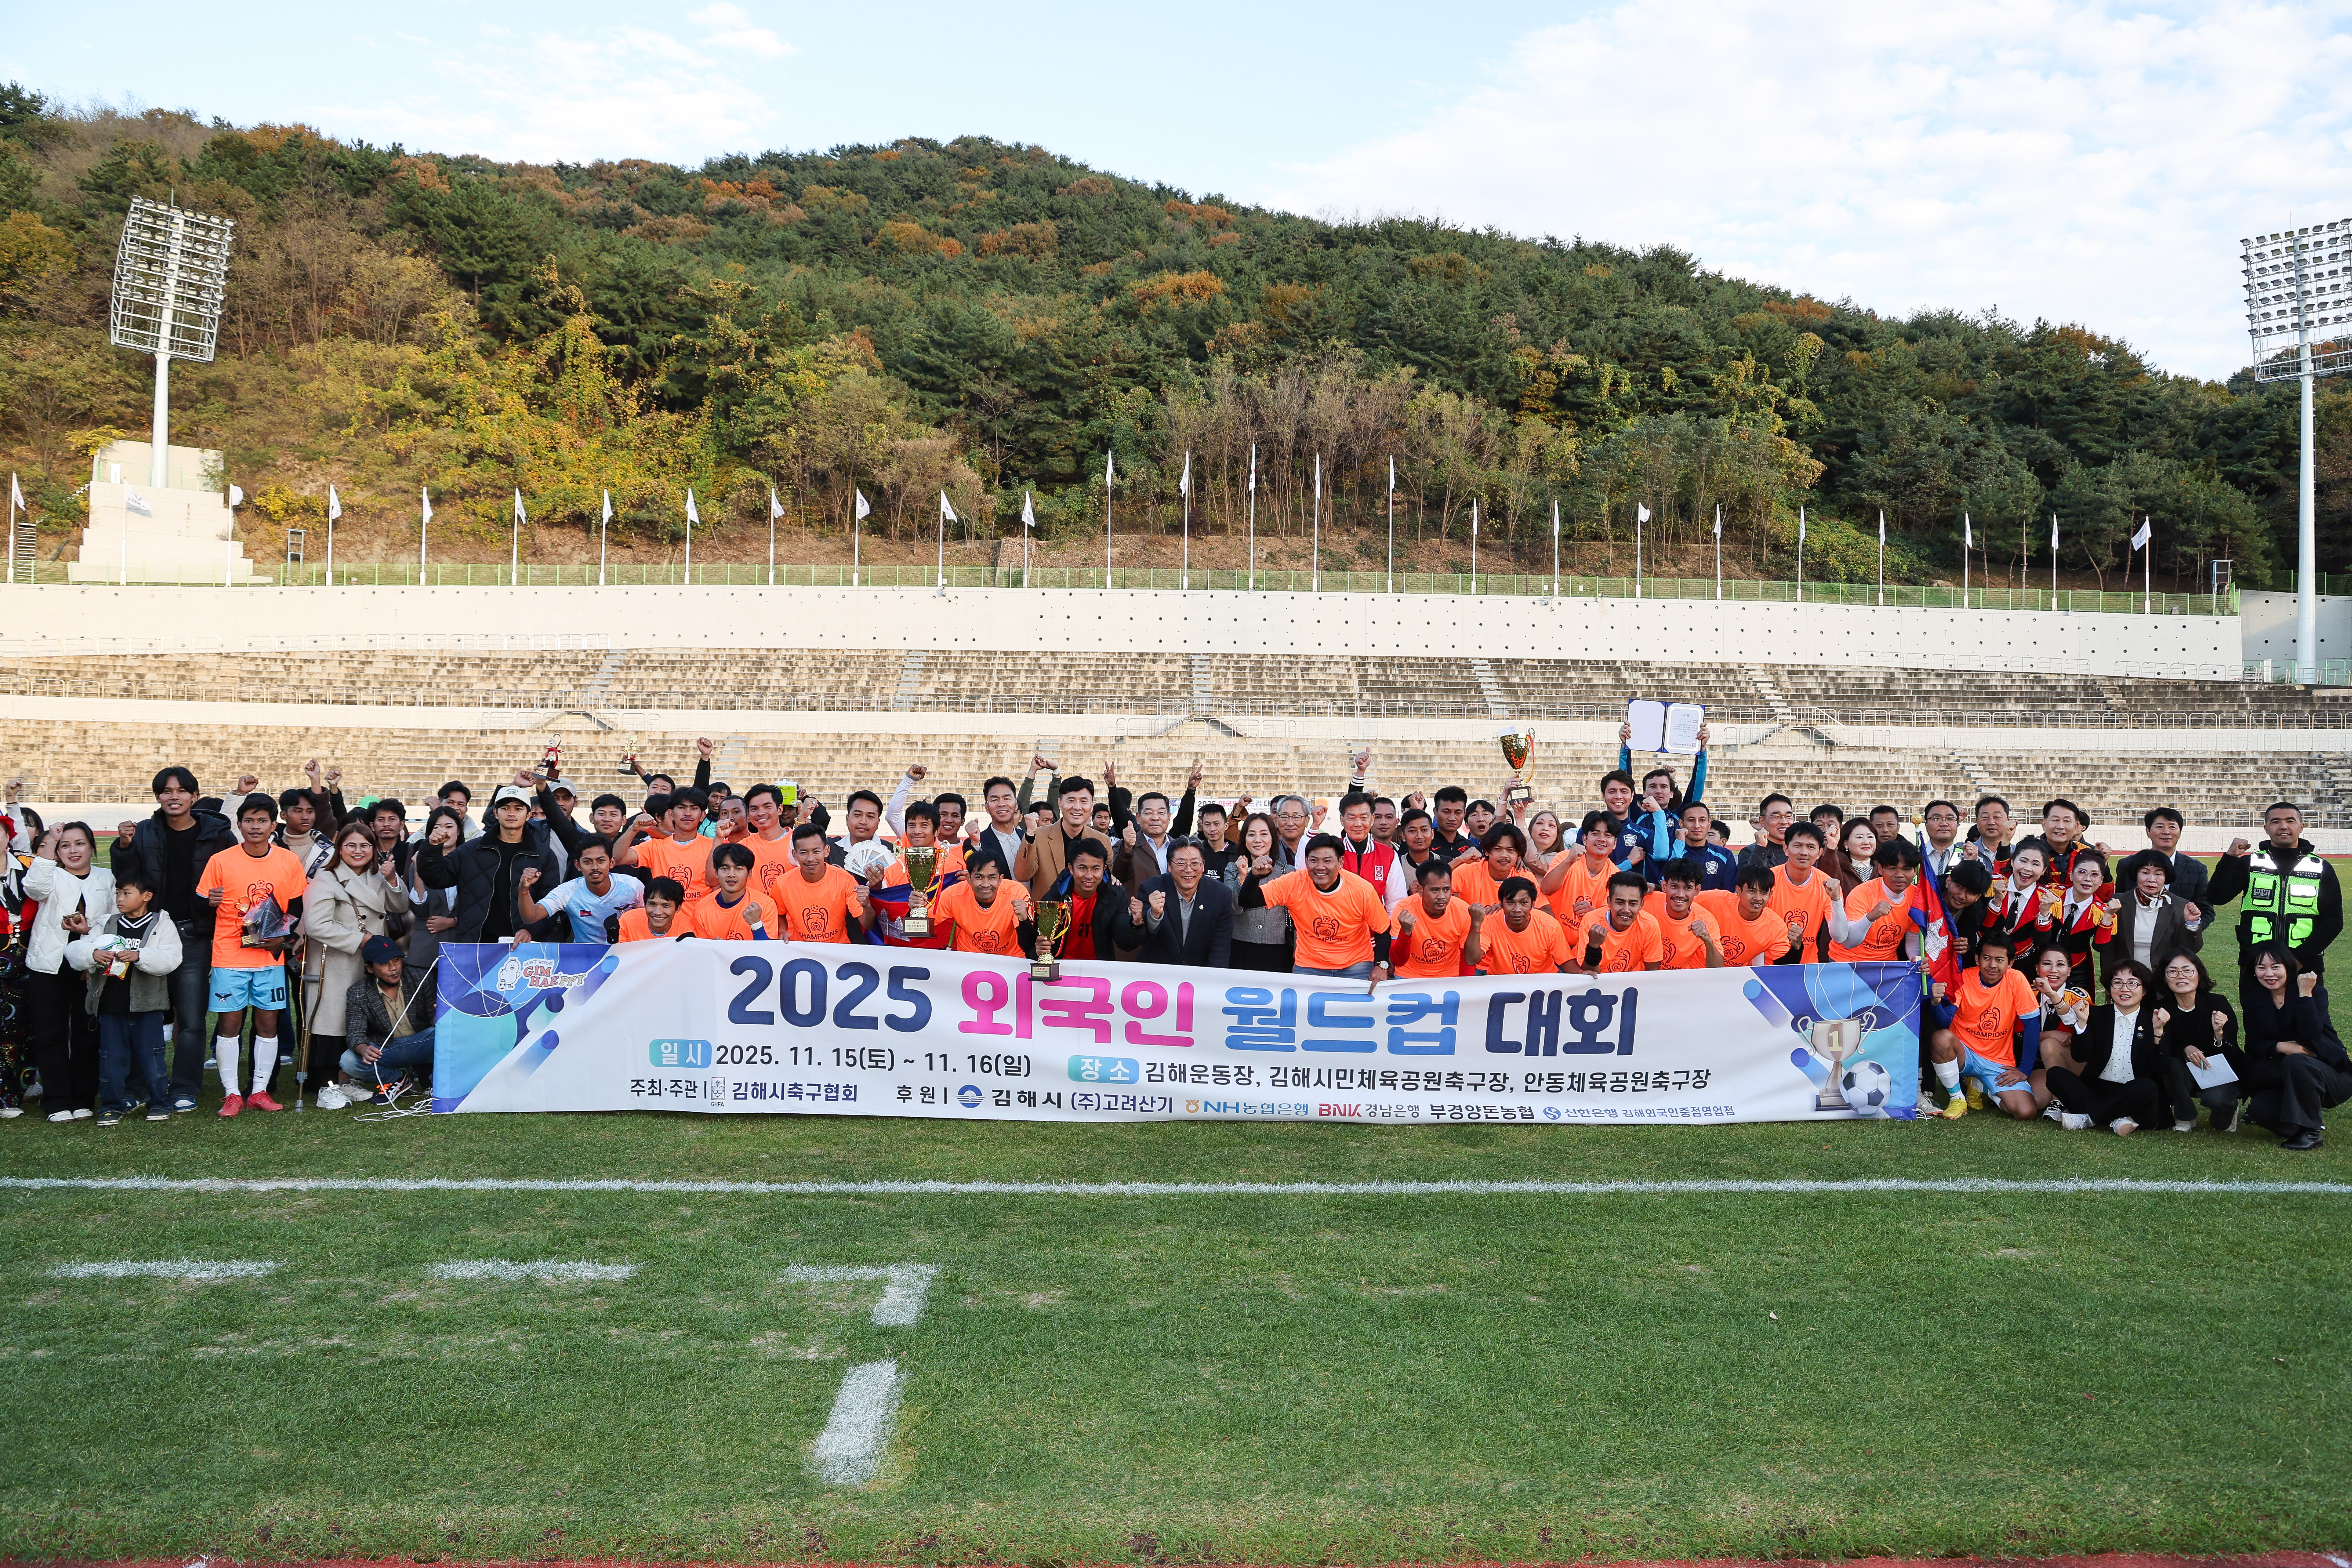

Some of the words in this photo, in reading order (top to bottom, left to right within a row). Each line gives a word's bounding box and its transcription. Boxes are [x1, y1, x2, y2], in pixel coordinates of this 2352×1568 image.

[799, 928, 838, 940] CHAMPIONS
[1078, 923, 1089, 938] 21
[972, 939, 1009, 953] CHAMPIONS
[1411, 953, 1446, 963] CHAMPIO
[523, 965, 552, 977] GIM
[270, 987, 285, 1002] 10
[728, 955, 932, 1033] 2025
[958, 970, 1195, 1047] 외국인
[1221, 987, 1460, 1056] 월드컵
[1485, 987, 1638, 1057] 대회
[1966, 1028, 2008, 1038] CHAMPIONS
[1829, 1031, 1843, 1051] 1
[716, 1045, 779, 1065] 2025.
[790, 1046, 821, 1066] 11.
[833, 1047, 895, 1071] 15(토)
[925, 1053, 956, 1072] 11.
[967, 1054, 1031, 1078] 16(일)
[1146, 1062, 1260, 1087] 김해운동장,
[1270, 1066, 1514, 1093] 김해시민체육공원축구장,
[1524, 1069, 1711, 1093] 안동체육공원축구장
[630, 1078, 698, 1099] 주최·주관
[732, 1082, 857, 1102] 김해시축구협회
[1071, 1092, 1172, 1113] (주)고려산기
[1318, 1103, 1362, 1117] BNK
[1365, 1104, 1419, 1118] 경남은행
[1430, 1104, 1533, 1120] 부경양돈농협
[1564, 1108, 1619, 1118] 신한은행
[1622, 1105, 1735, 1118] 김해외국인중점영업점
